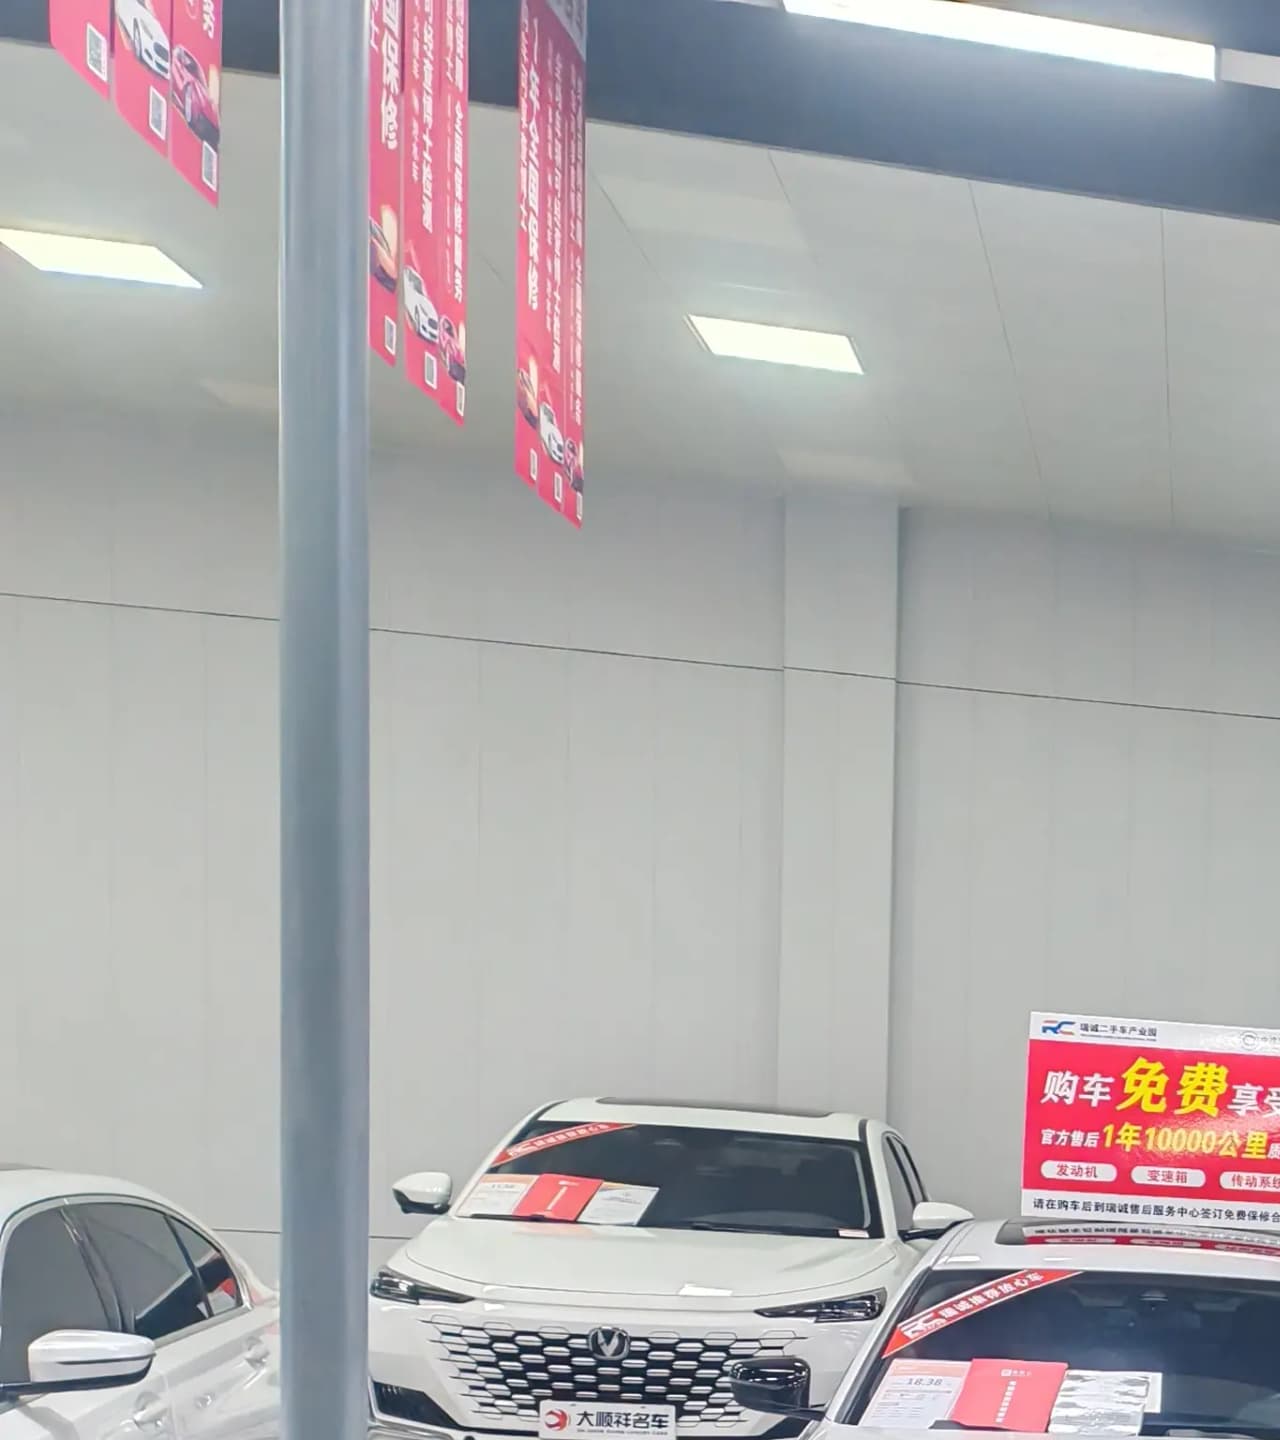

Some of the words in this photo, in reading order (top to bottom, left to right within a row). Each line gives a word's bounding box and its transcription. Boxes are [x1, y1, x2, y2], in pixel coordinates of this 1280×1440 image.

[1056, 1163, 1099, 1179] 发动机
[1147, 1169, 1189, 1184] 变速箱
[576, 1411, 670, 1429] 大顺祥名车
